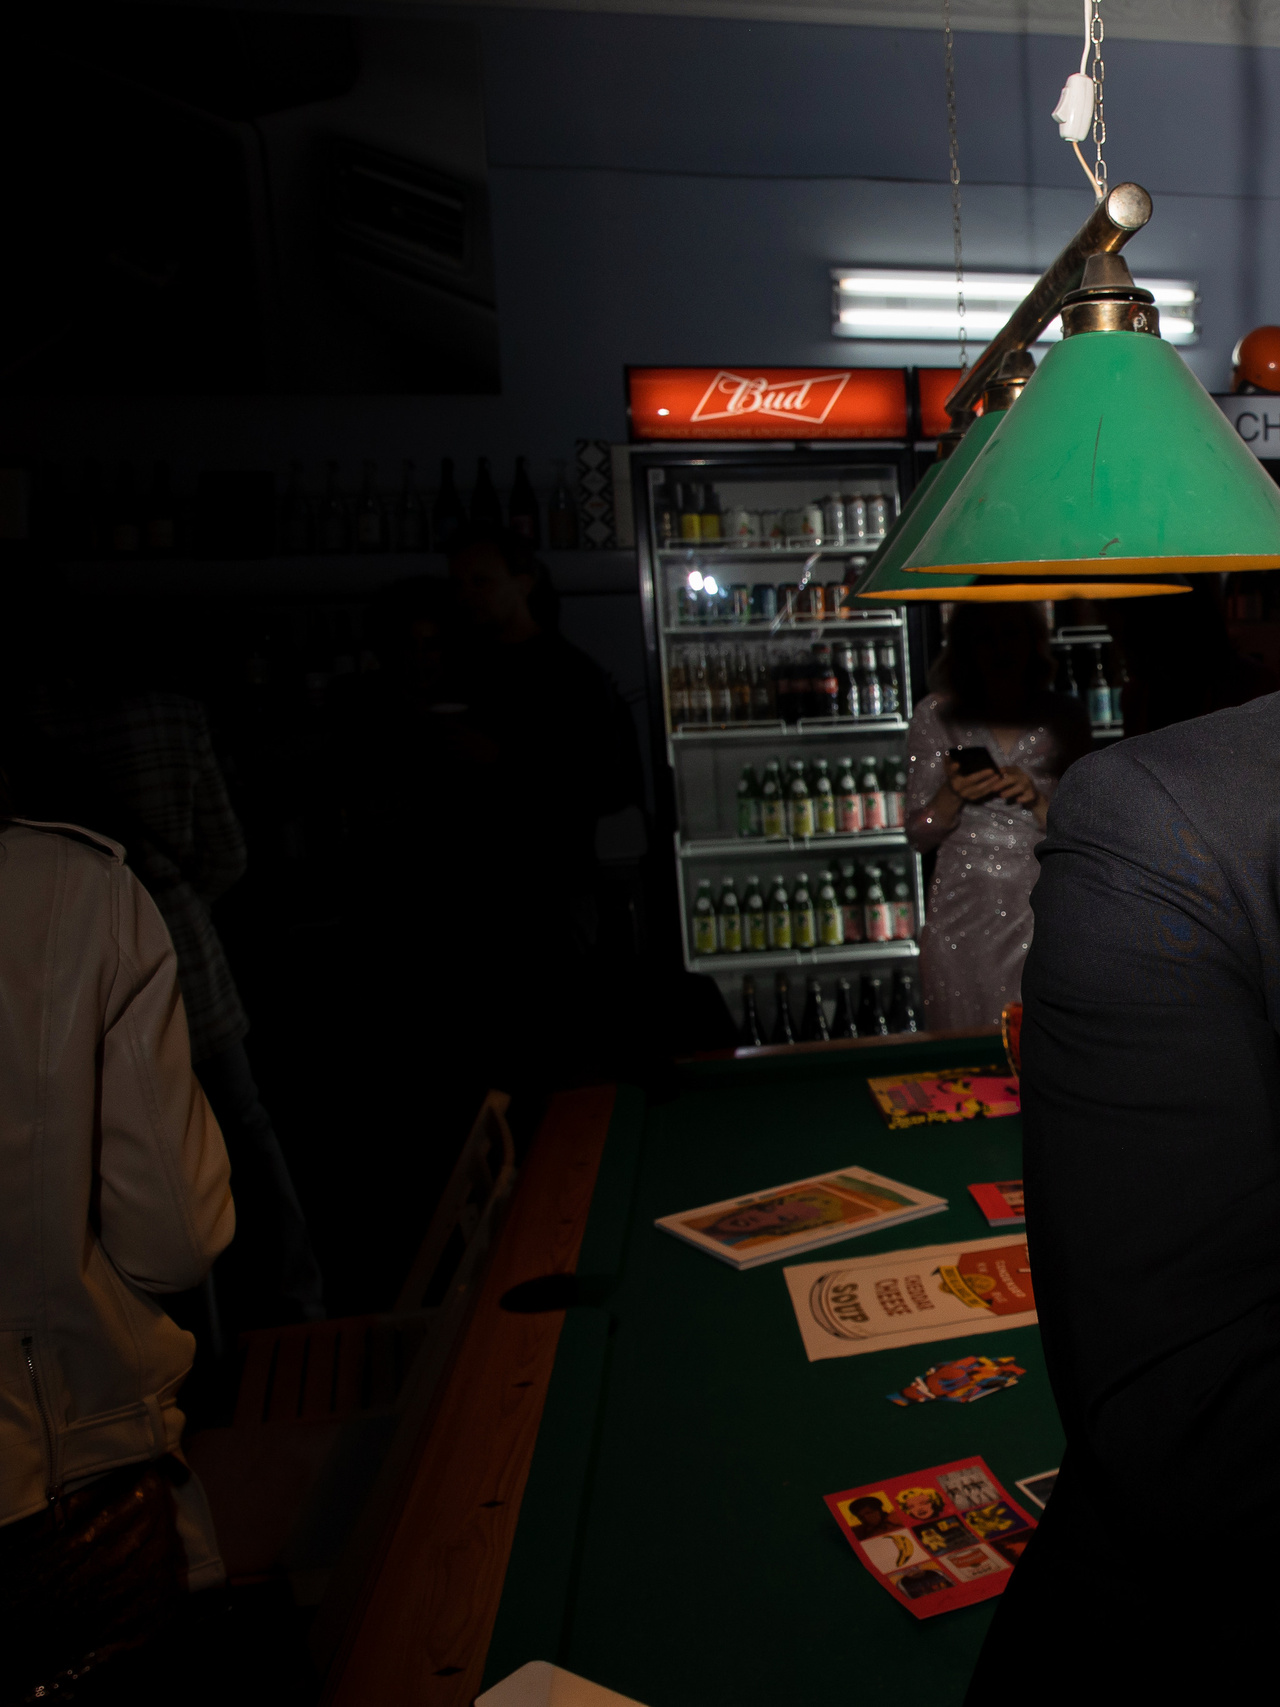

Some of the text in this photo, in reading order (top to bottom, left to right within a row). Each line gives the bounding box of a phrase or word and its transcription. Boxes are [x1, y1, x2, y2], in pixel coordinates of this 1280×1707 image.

[717, 376, 811, 414] Bud
[831, 1282, 870, 1323] SOUP
[874, 1277, 913, 1317] CHEESE
